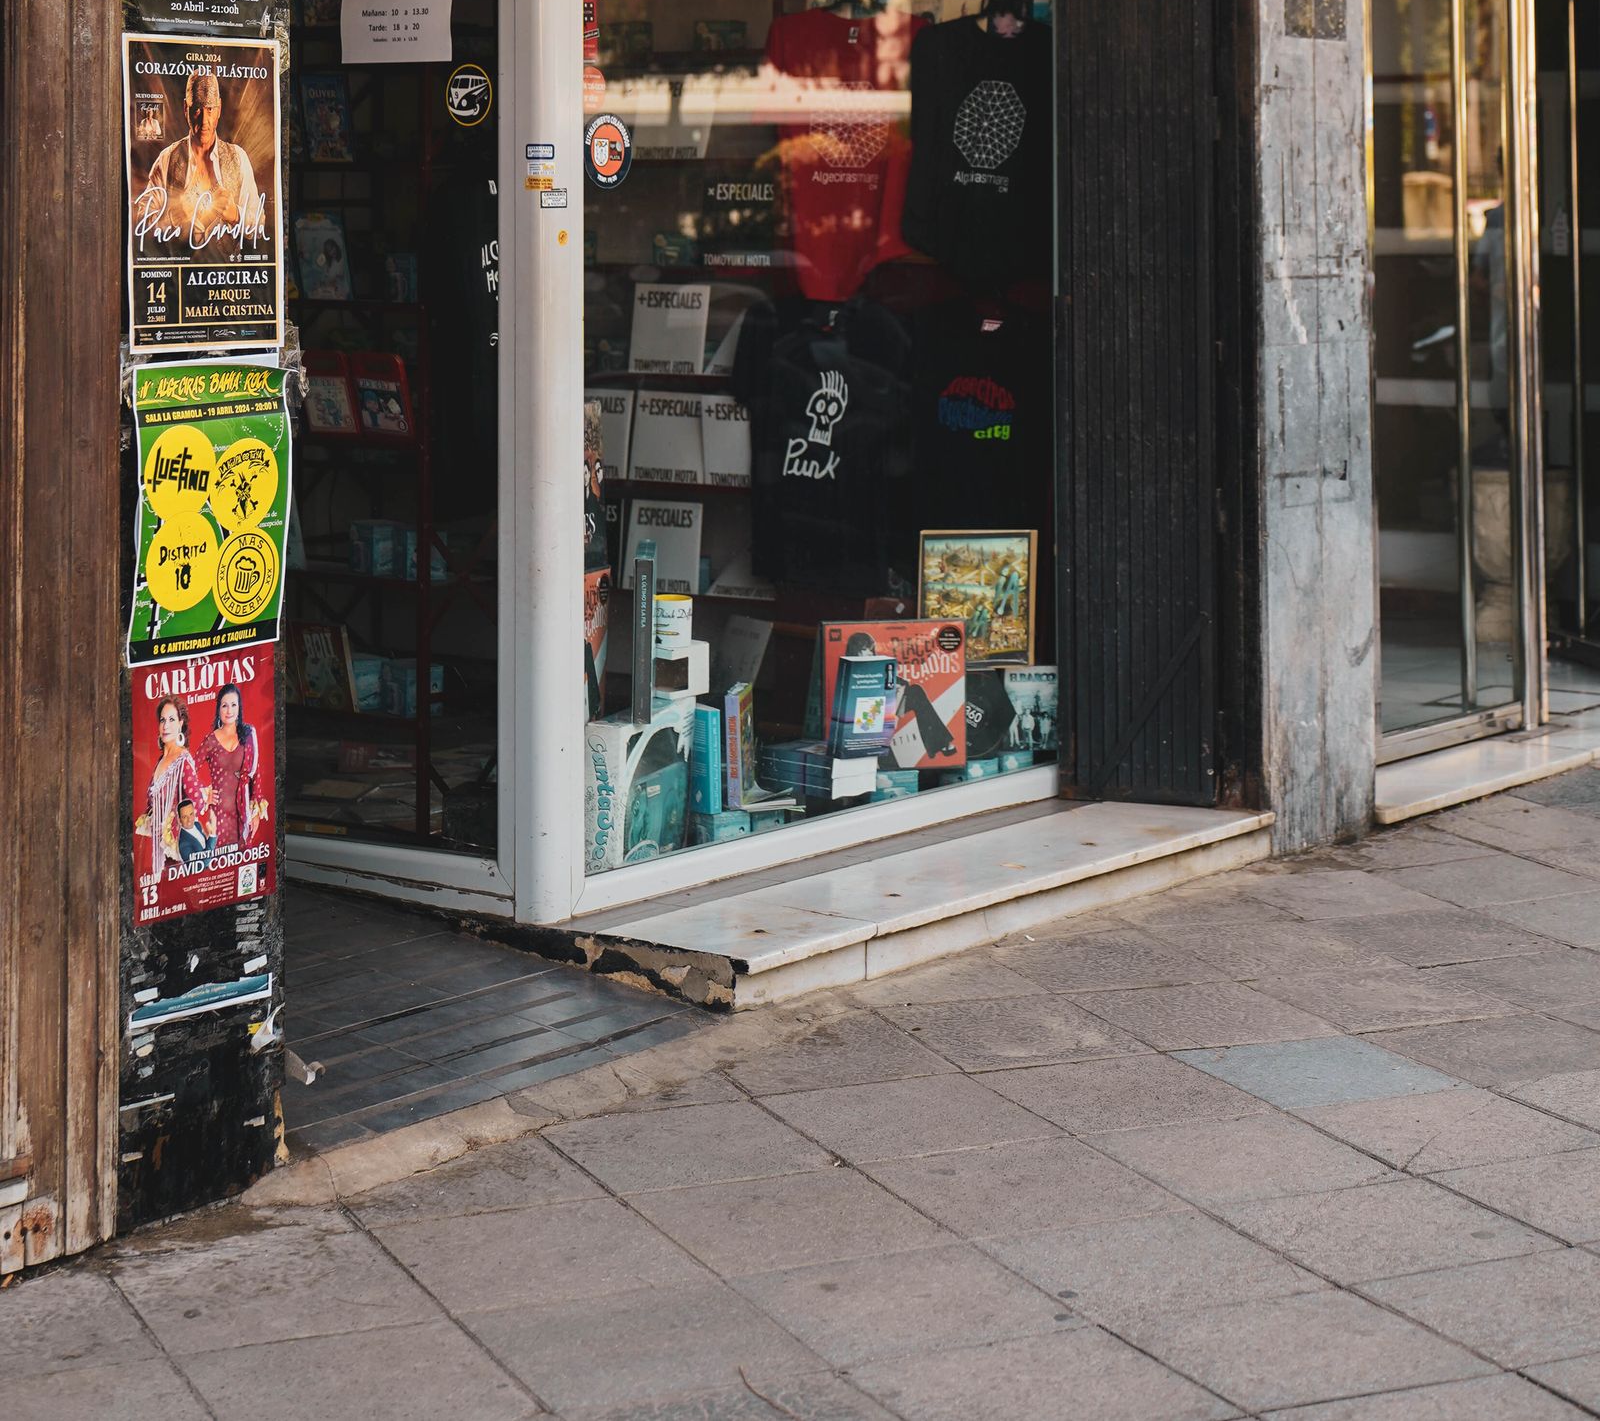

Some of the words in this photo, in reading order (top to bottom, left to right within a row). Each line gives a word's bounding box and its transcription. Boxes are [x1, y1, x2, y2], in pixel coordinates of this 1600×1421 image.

[171, 3, 182, 11] 20
[183, 2, 204, 12] Abril
[211, 5, 240, 15] 21:00h
[361, 8, 387, 17] Mañana:
[368, 24, 387, 32] Tarde:
[393, 23, 400, 31] 18
[186, 52, 204, 61] GIRA
[205, 54, 222, 62] 2024
[135, 61, 194, 77] CORAZÓN
[198, 64, 212, 77] DE
[216, 64, 268, 80] PLÁSTICO
[134, 186, 181, 252] Paco
[189, 191, 270, 250] Candela
[703, 253, 745, 266] TOMOYUKI
[746, 254, 771, 266] HOTTA
[186, 270, 268, 286] ALGECIRAS
[146, 282, 166, 303] 14
[208, 289, 250, 302] PARQUE
[147, 306, 166, 315] JULIO
[185, 303, 220, 317] MARÍA
[222, 304, 274, 316] CRISTINA
[155, 376, 206, 402] ALGECIRAS
[244, 370, 279, 396] ROCK
[144, 413, 162, 423] SALA
[162, 412, 172, 422] LA
[172, 410, 203, 421] GRAMOLA
[207, 408, 215, 416] 19
[216, 405, 234, 415] ABRIL
[235, 404, 250, 413] 2024
[255, 402, 272, 412] 20:00
[273, 401, 278, 410] H
[782, 437, 840, 479] Punk
[674, 469, 698, 483] HOTTA
[637, 507, 694, 528] ESPECIALES
[238, 536, 265, 550] MAS
[158, 541, 207, 566] DISTRITO
[174, 562, 192, 591] 10
[220, 592, 262, 614] MADERA
[153, 645, 159, 655] 8
[160, 644, 166, 653] €
[167, 637, 211, 653] ANTICIPADA
[212, 635, 220, 645] 10
[221, 634, 227, 644] €
[227, 627, 257, 642] TAQUILLA
[145, 656, 255, 700] CARLOTAS
[187, 695, 195, 704] En
[195, 691, 216, 703] Concierto
[168, 860, 205, 882] DAVID
[208, 842, 270, 872] CORDOBÉS
[189, 850, 215, 861] ARTISTA
[141, 884, 158, 906] 13
[140, 906, 160, 921] ABRIL
